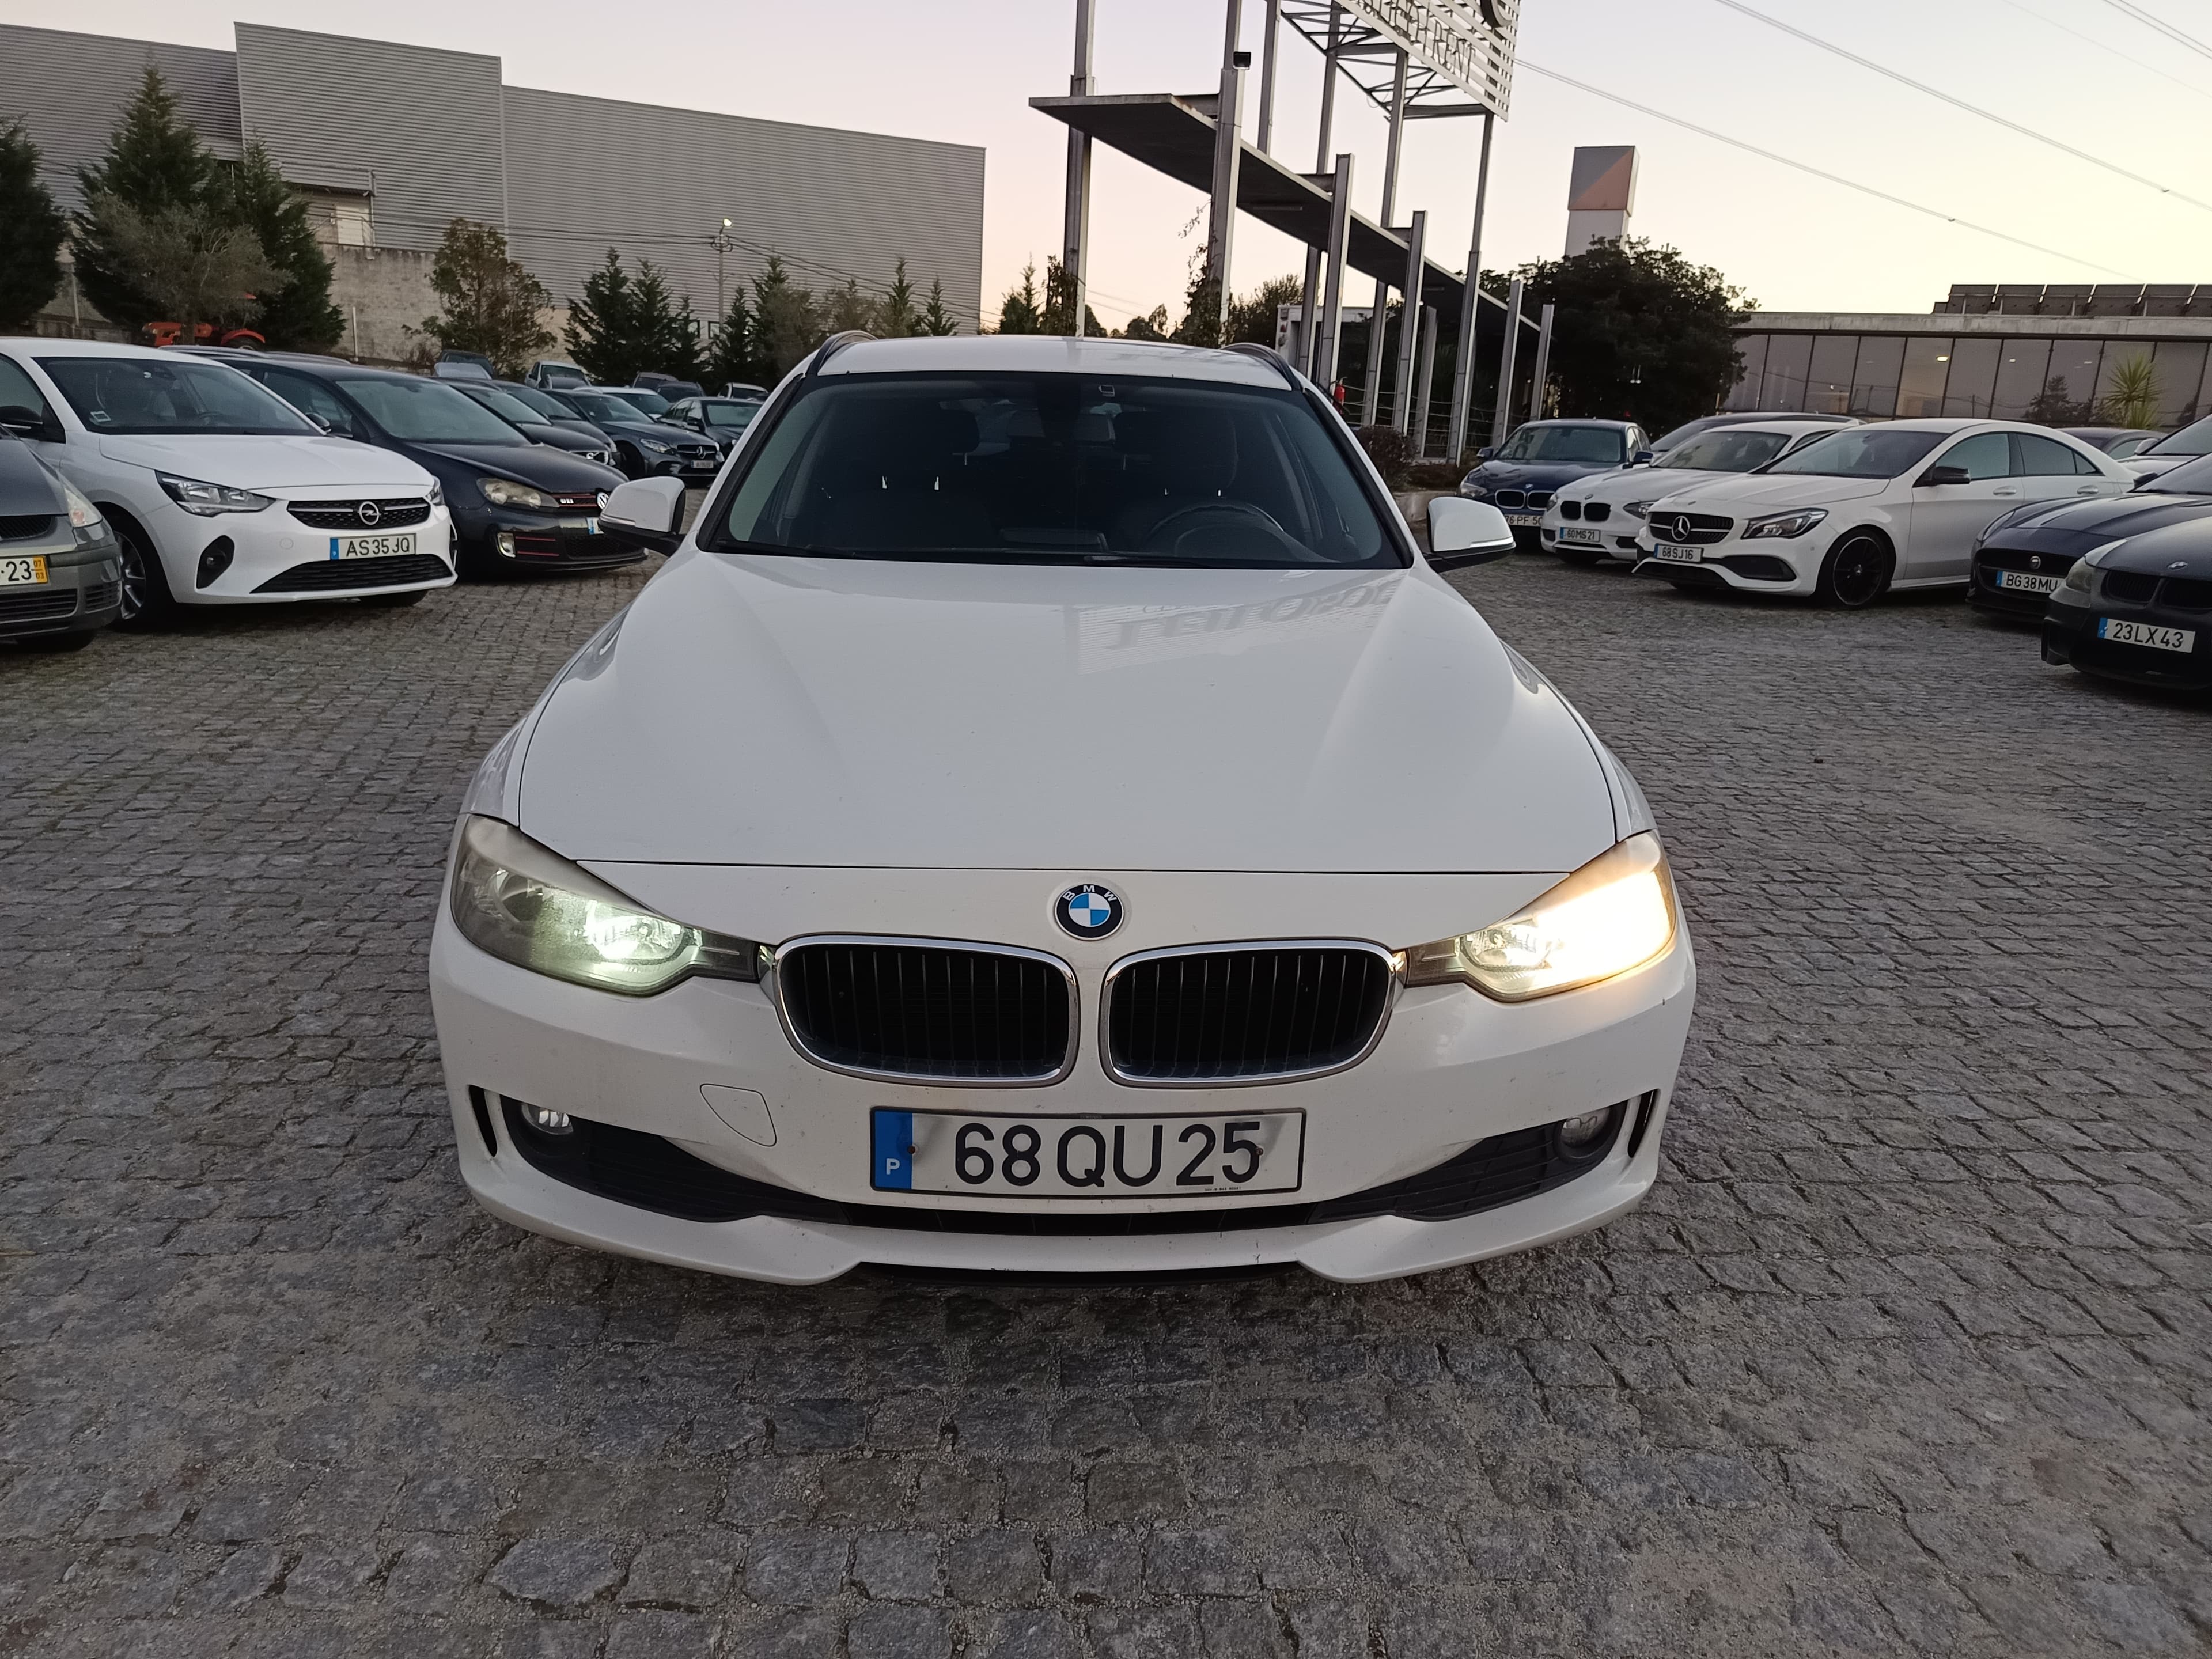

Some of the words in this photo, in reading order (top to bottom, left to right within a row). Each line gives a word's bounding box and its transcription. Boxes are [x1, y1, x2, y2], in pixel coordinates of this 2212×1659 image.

[346, 537, 410, 557] AS35JQ
[1062, 885, 1118, 902] BMW
[886, 1158, 900, 1175] P
